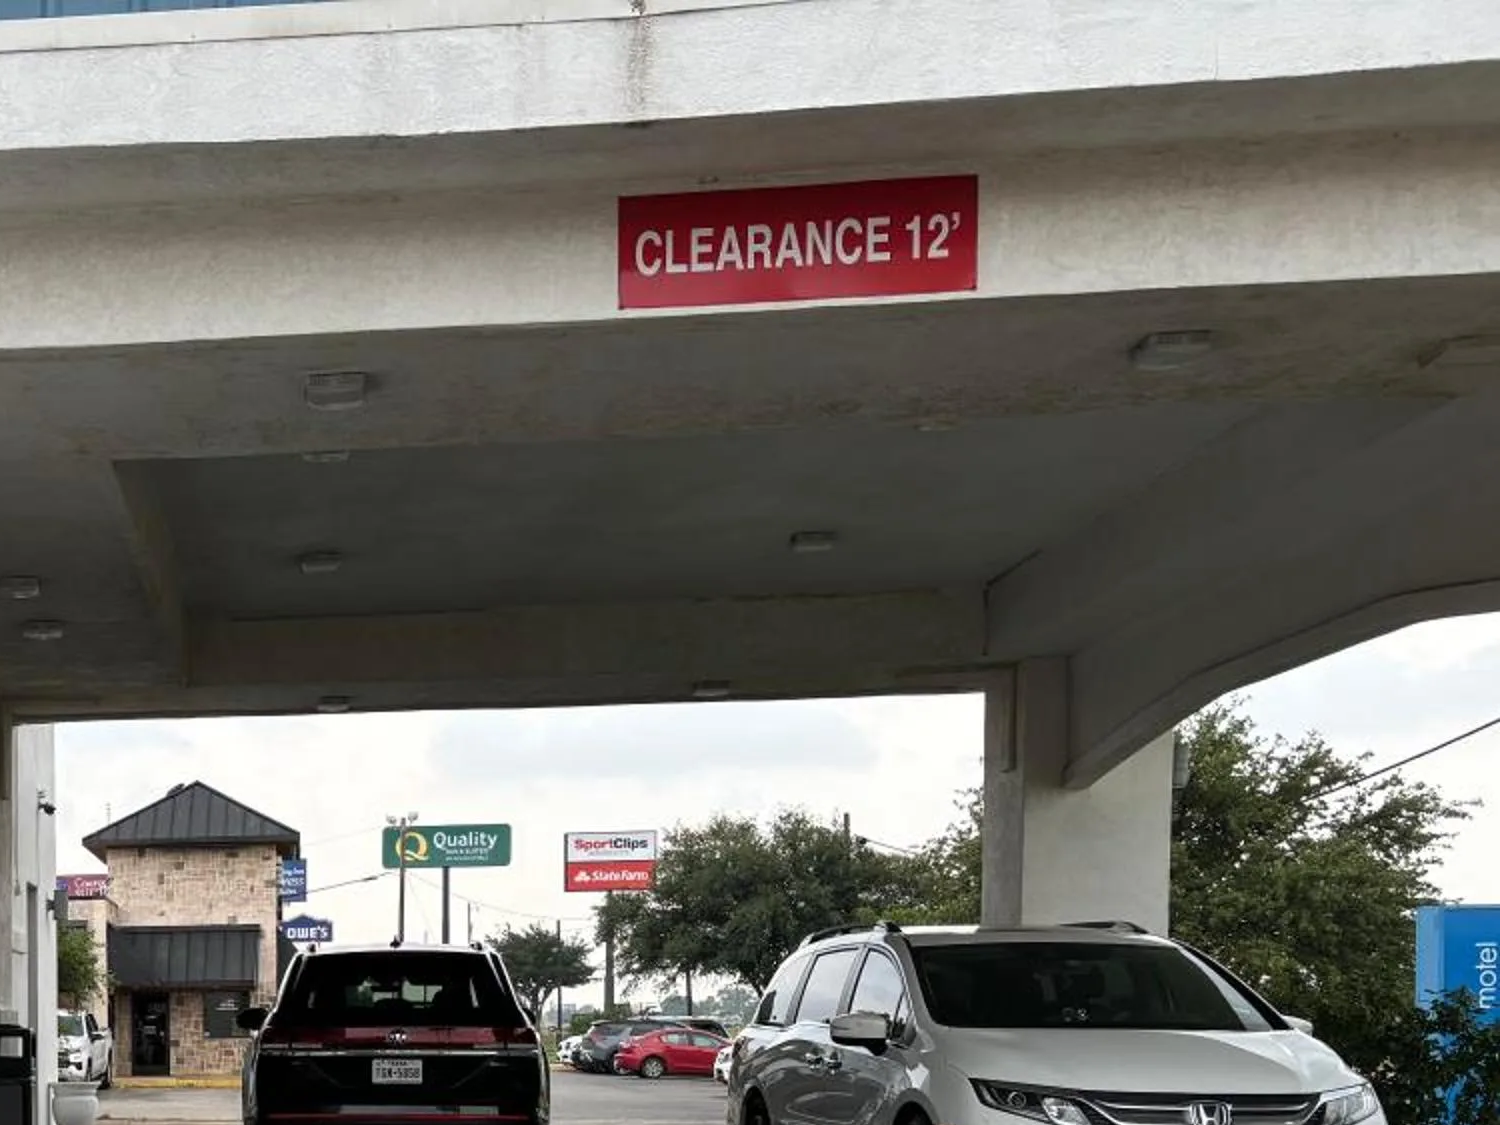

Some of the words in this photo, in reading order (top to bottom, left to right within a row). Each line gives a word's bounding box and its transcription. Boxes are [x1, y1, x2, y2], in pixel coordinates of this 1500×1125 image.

[635, 216, 891, 277] CLEARANCE
[433, 831, 498, 851] Quality
[279, 926, 329, 939] OWE'S
[1476, 942, 1497, 1009] motel
